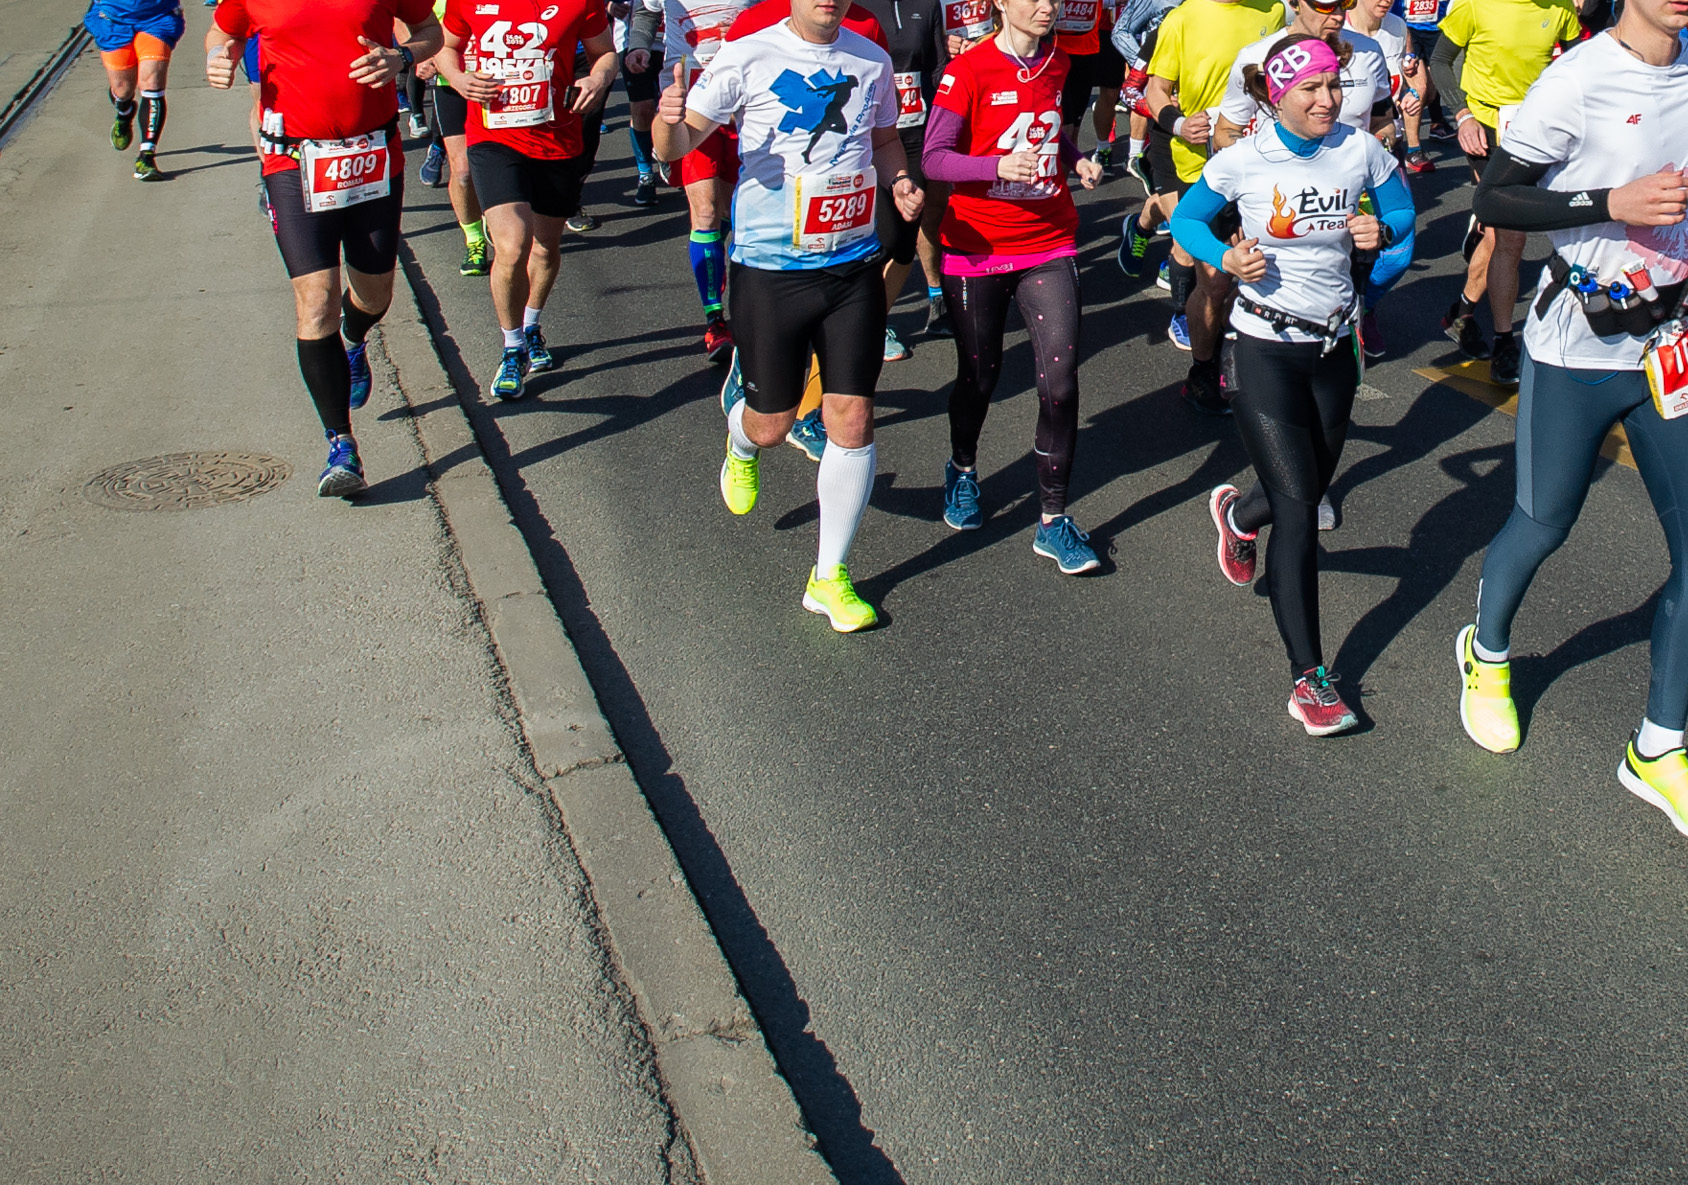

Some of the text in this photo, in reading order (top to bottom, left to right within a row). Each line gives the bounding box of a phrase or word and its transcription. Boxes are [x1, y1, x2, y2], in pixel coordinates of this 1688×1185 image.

[1065, 2, 1094, 16] 4484
[1413, 0, 1434, 11] 2835
[480, 20, 549, 58] 42
[1268, 44, 1311, 89] RB
[499, 85, 541, 105] 4807
[997, 110, 1061, 154] 42
[325, 154, 377, 181] 4809
[818, 193, 867, 223] 5289
[1291, 186, 1355, 214] Evil
[1317, 219, 1348, 231] Tea
